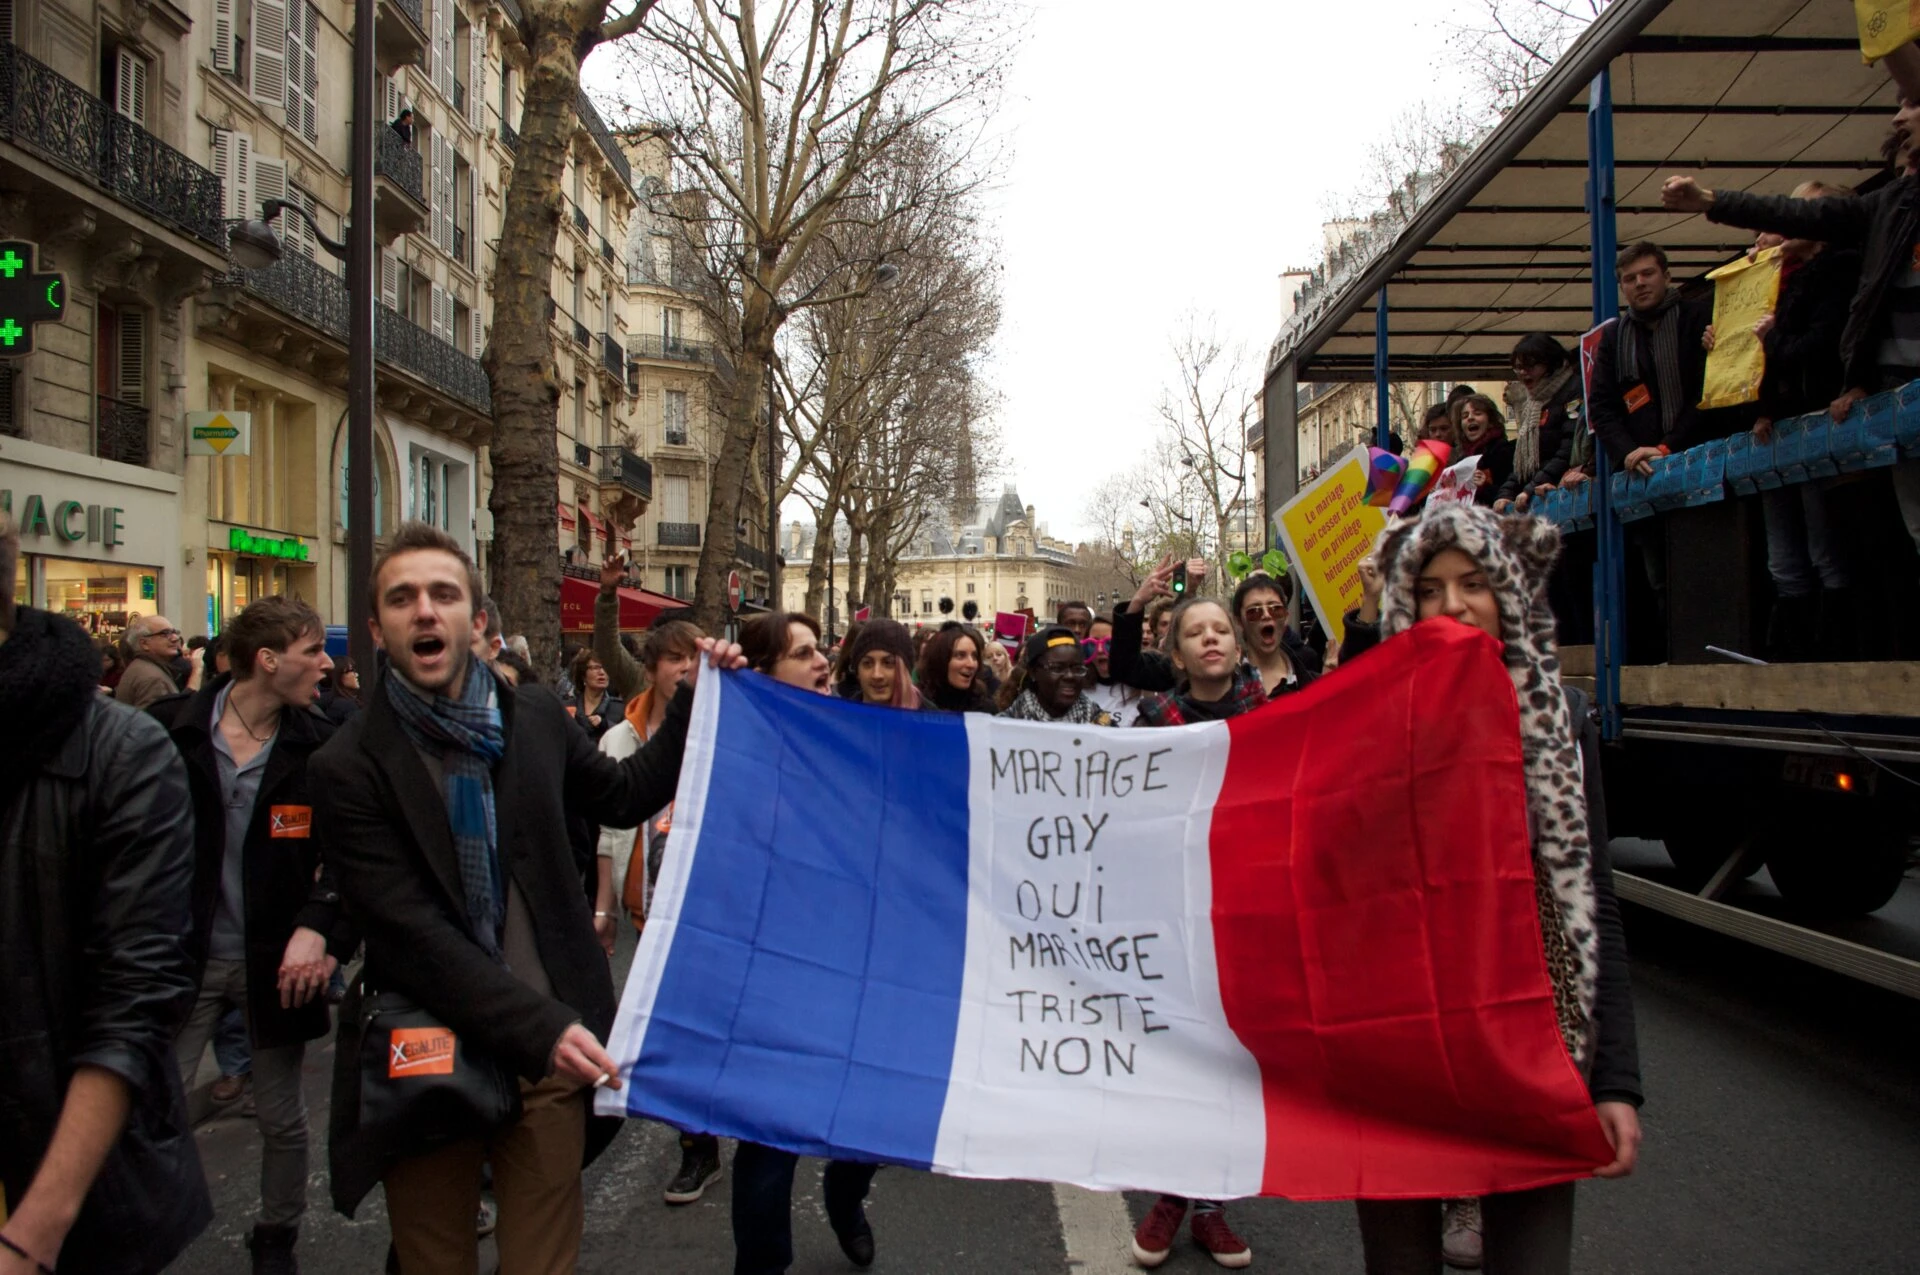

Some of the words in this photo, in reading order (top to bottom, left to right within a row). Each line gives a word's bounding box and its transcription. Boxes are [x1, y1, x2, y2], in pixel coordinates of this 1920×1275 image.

[1304, 511, 1317, 525] Le
[1315, 483, 1345, 515] mariage
[1303, 532, 1318, 552] doit
[1317, 512, 1341, 538] cesser
[1321, 546, 1331, 561] un
[1331, 518, 1362, 555] privilège
[1338, 571, 1360, 600] panto
[1027, 813, 1109, 860] GAY
[1020, 1037, 1136, 1077] NON
